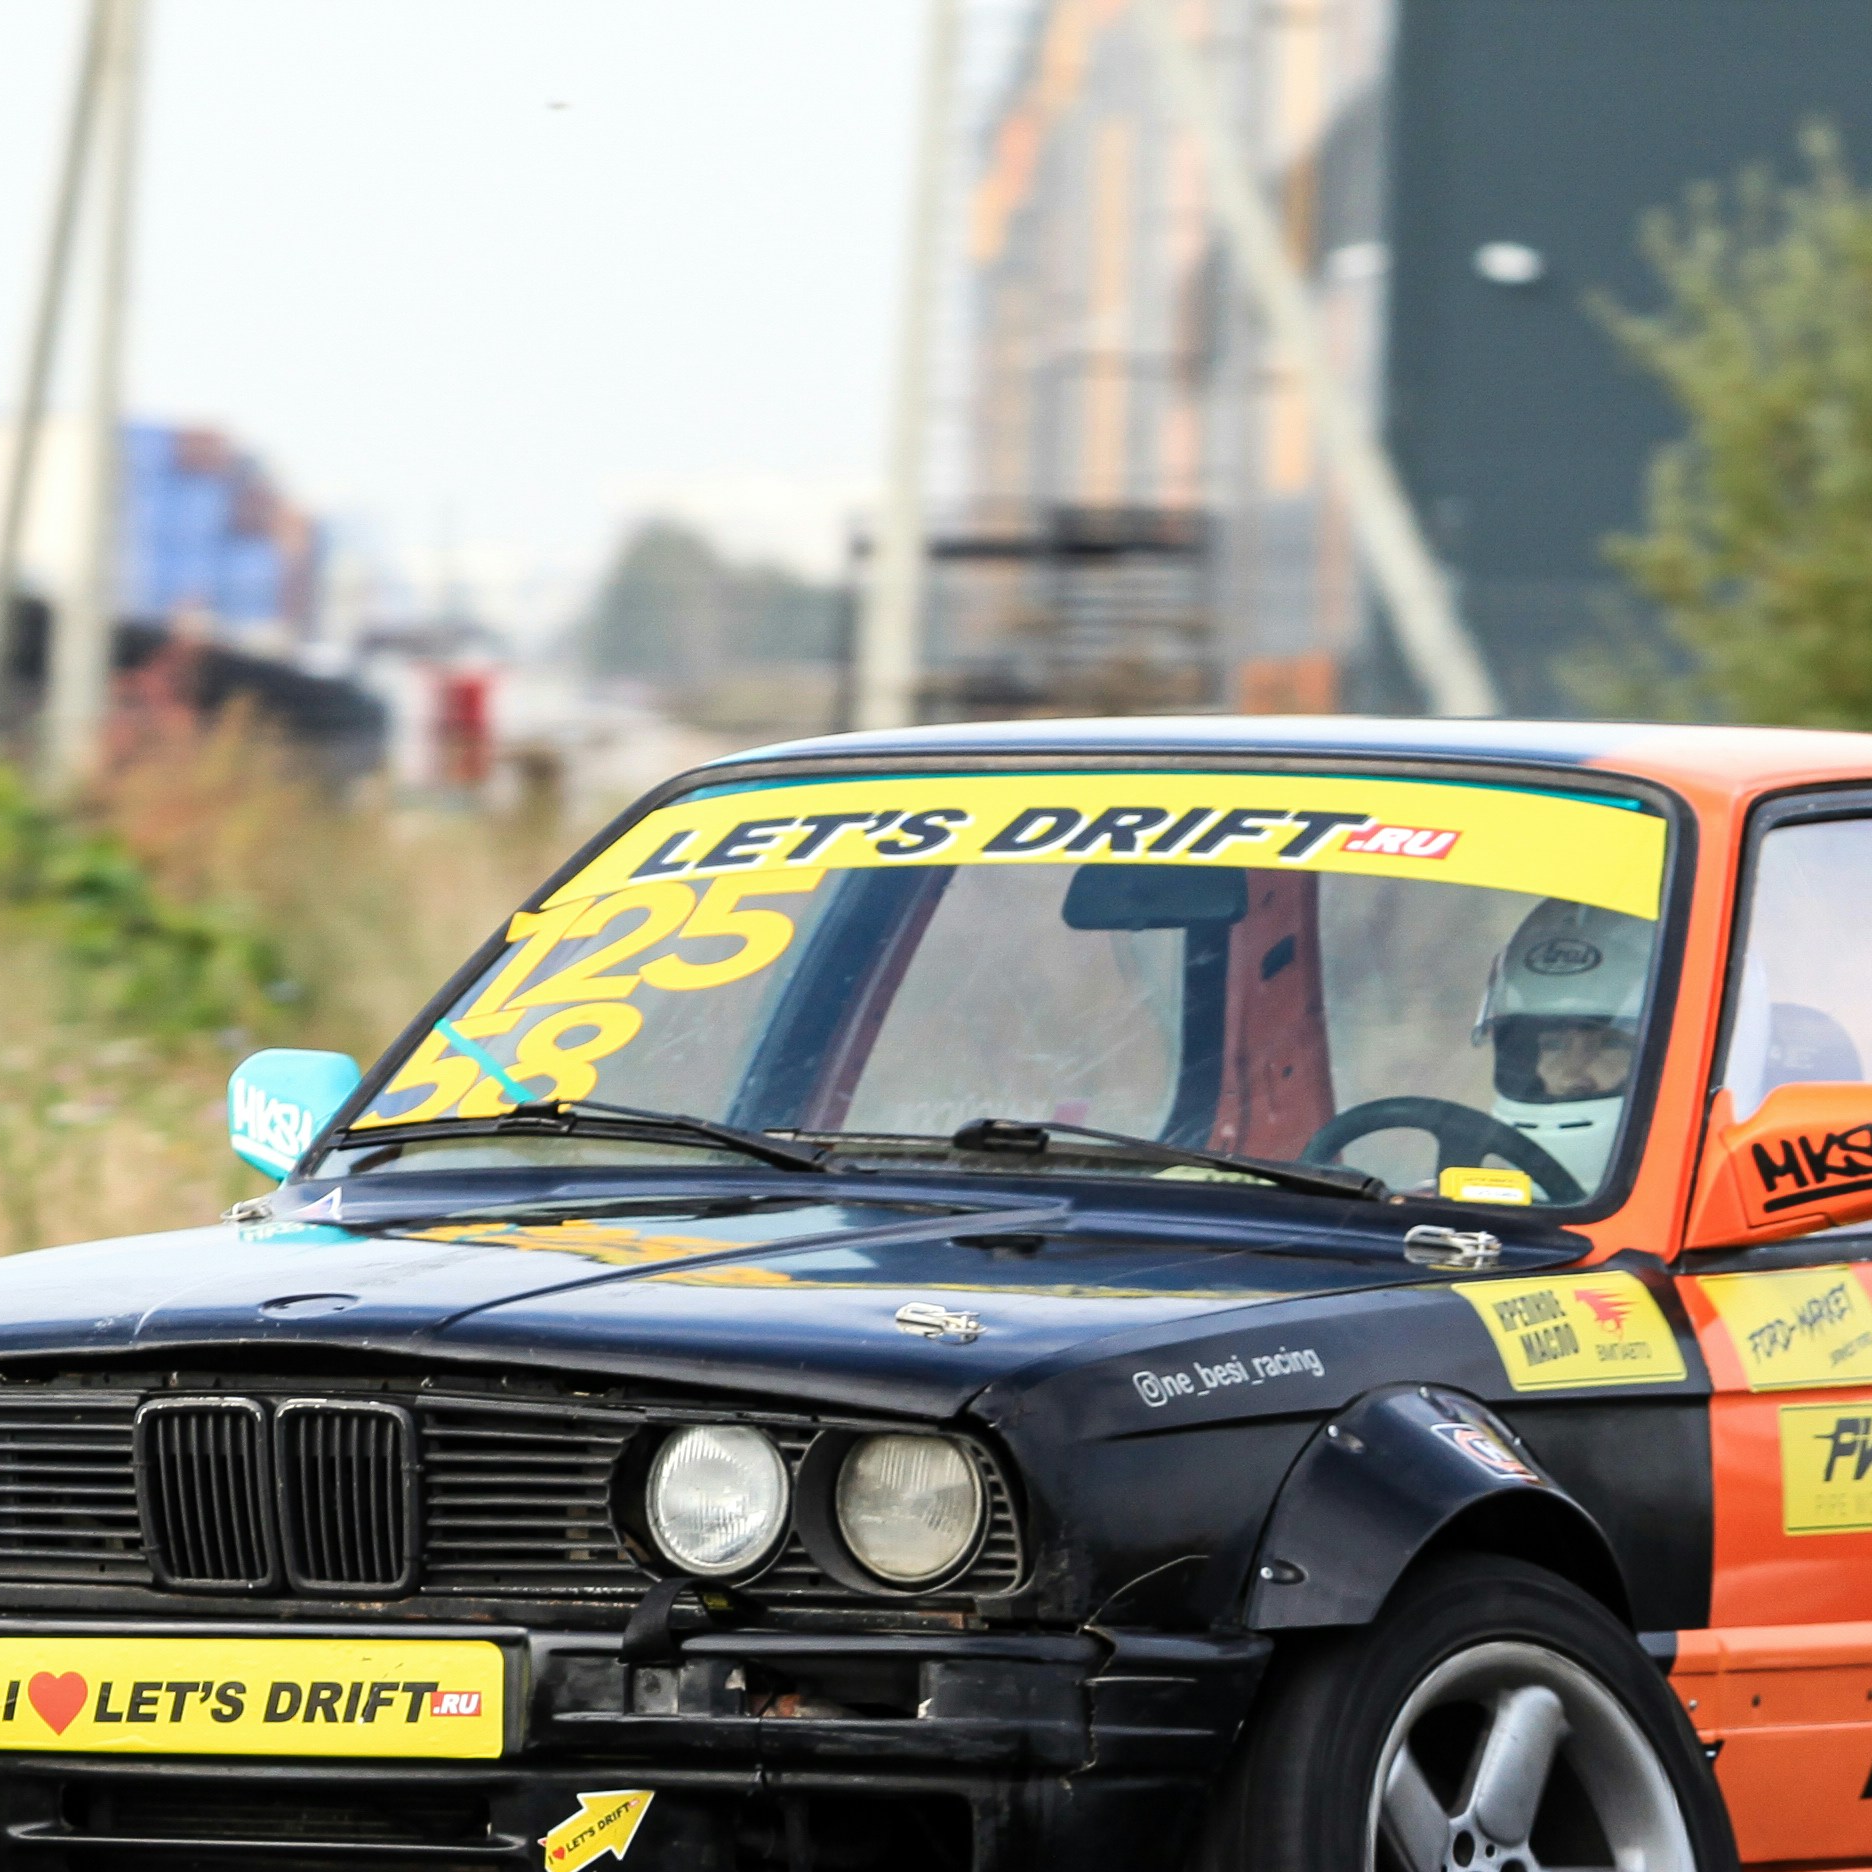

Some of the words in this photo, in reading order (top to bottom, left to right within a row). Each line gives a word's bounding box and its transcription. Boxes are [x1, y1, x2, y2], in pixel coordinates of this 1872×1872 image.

[627, 808, 970, 880] LET'S
[463, 868, 827, 1019] 125
[350, 1002, 643, 1129] 58
[1520, 1321, 1580, 1368] МАСЛО
[1, 1679, 21, 1722] I
[93, 1679, 247, 1723] LET'S
[566, 1826, 596, 1852] LET'S
